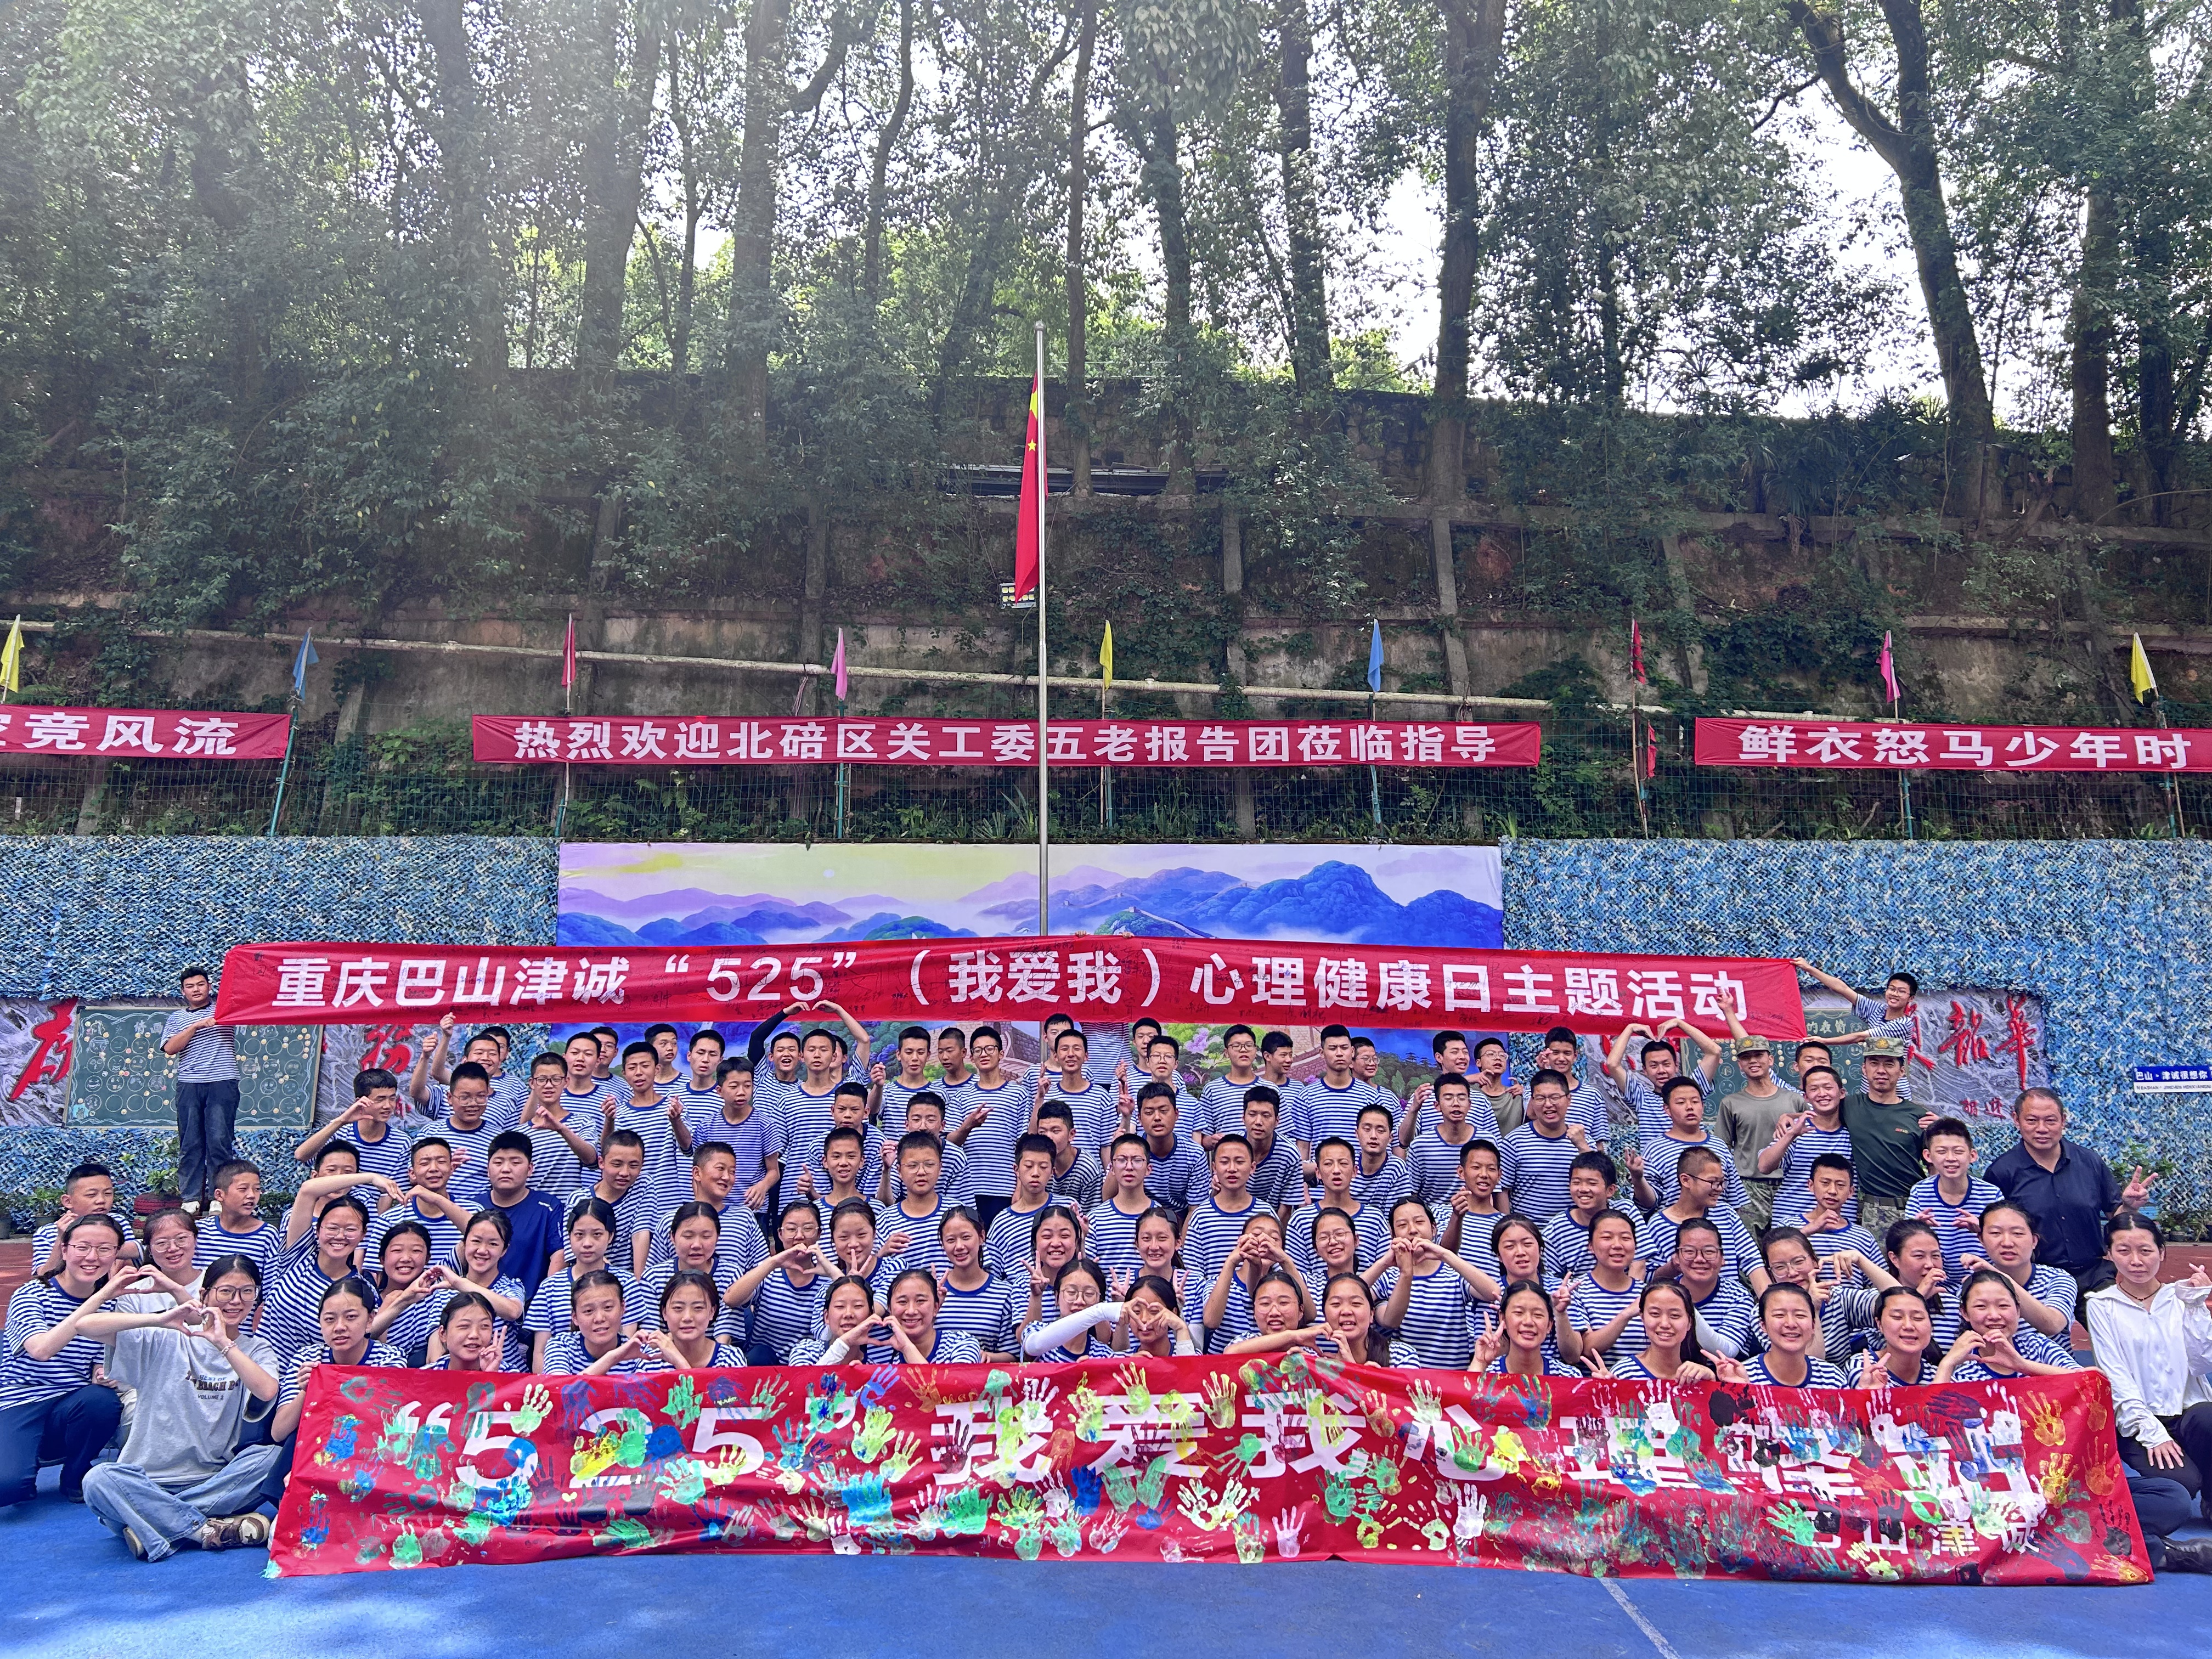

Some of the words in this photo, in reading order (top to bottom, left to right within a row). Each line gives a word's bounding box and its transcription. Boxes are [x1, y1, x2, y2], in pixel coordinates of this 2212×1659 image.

[0, 712, 239, 755] 竞风流
[514, 721, 1496, 763] 热烈欢迎北碚区关工委五老报告团莅临指导
[1738, 724, 2192, 769] 鲜衣怒马少年时
